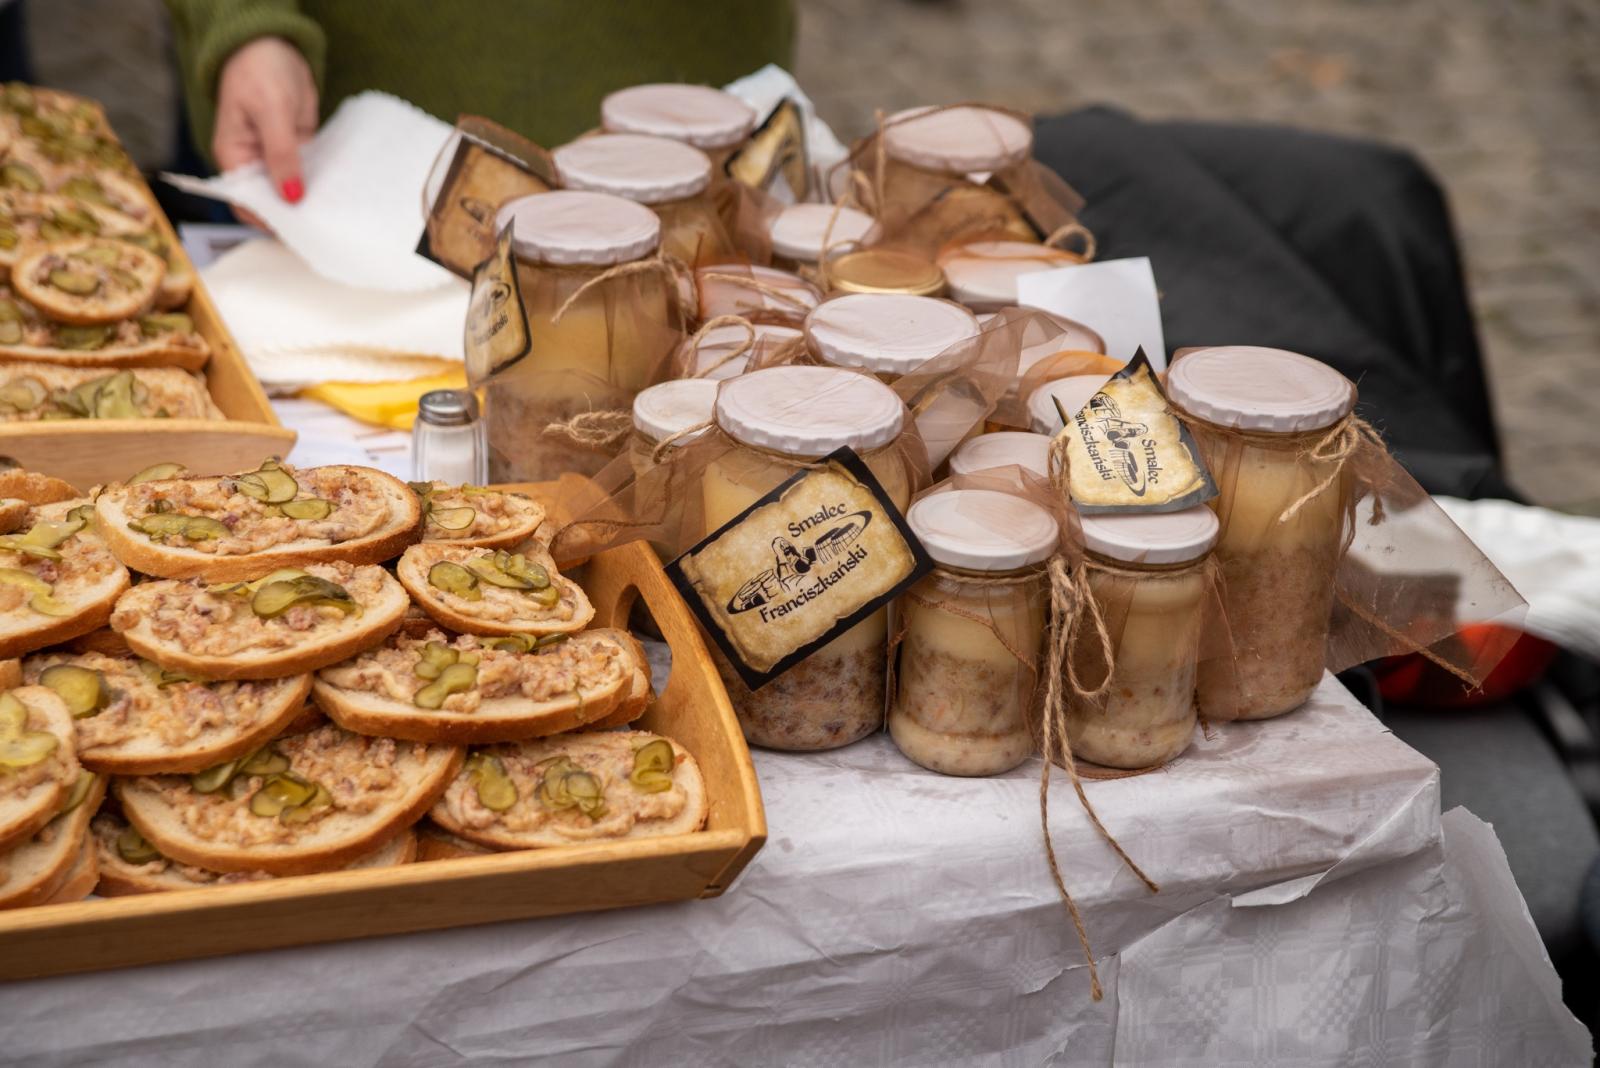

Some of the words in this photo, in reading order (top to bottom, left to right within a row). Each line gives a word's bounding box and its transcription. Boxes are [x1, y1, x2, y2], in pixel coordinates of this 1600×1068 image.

[1074, 405, 1117, 481] anciszkański
[1141, 439, 1164, 485] Smalec
[787, 502, 848, 539] Smalec
[759, 544, 868, 624] Franciszkański
